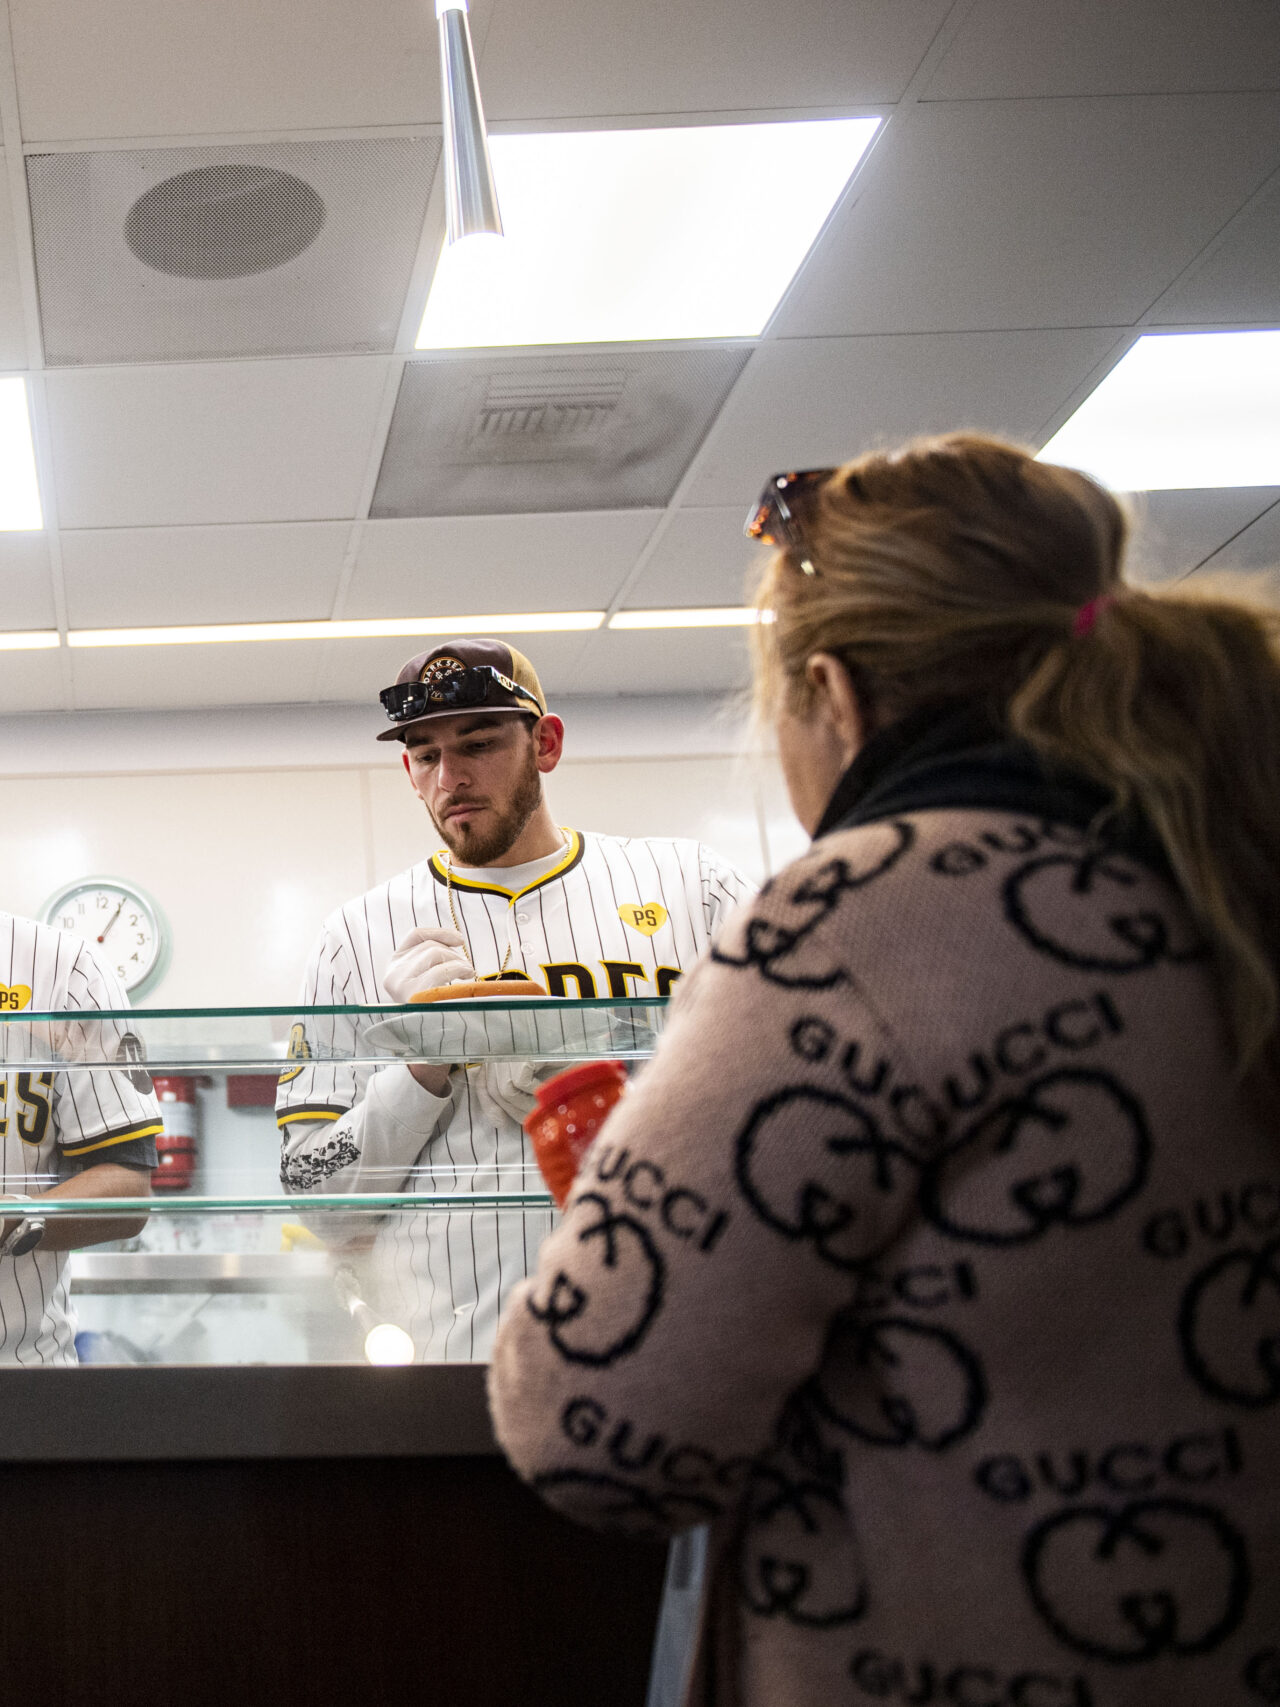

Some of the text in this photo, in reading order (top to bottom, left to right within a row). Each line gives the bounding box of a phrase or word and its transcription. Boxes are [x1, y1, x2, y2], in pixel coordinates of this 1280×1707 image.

[78, 903, 85, 914] 11
[96, 896, 108, 909] 12
[63, 917, 74, 929] 10
[129, 914, 138, 926] 2
[633, 909, 657, 926] PS
[136, 933, 145, 945] 3
[130, 952, 139, 962] 4
[117, 966, 126, 978] 5
[598, 1147, 726, 1251] UCCI
[976, 1428, 1241, 1501] GUCCI
